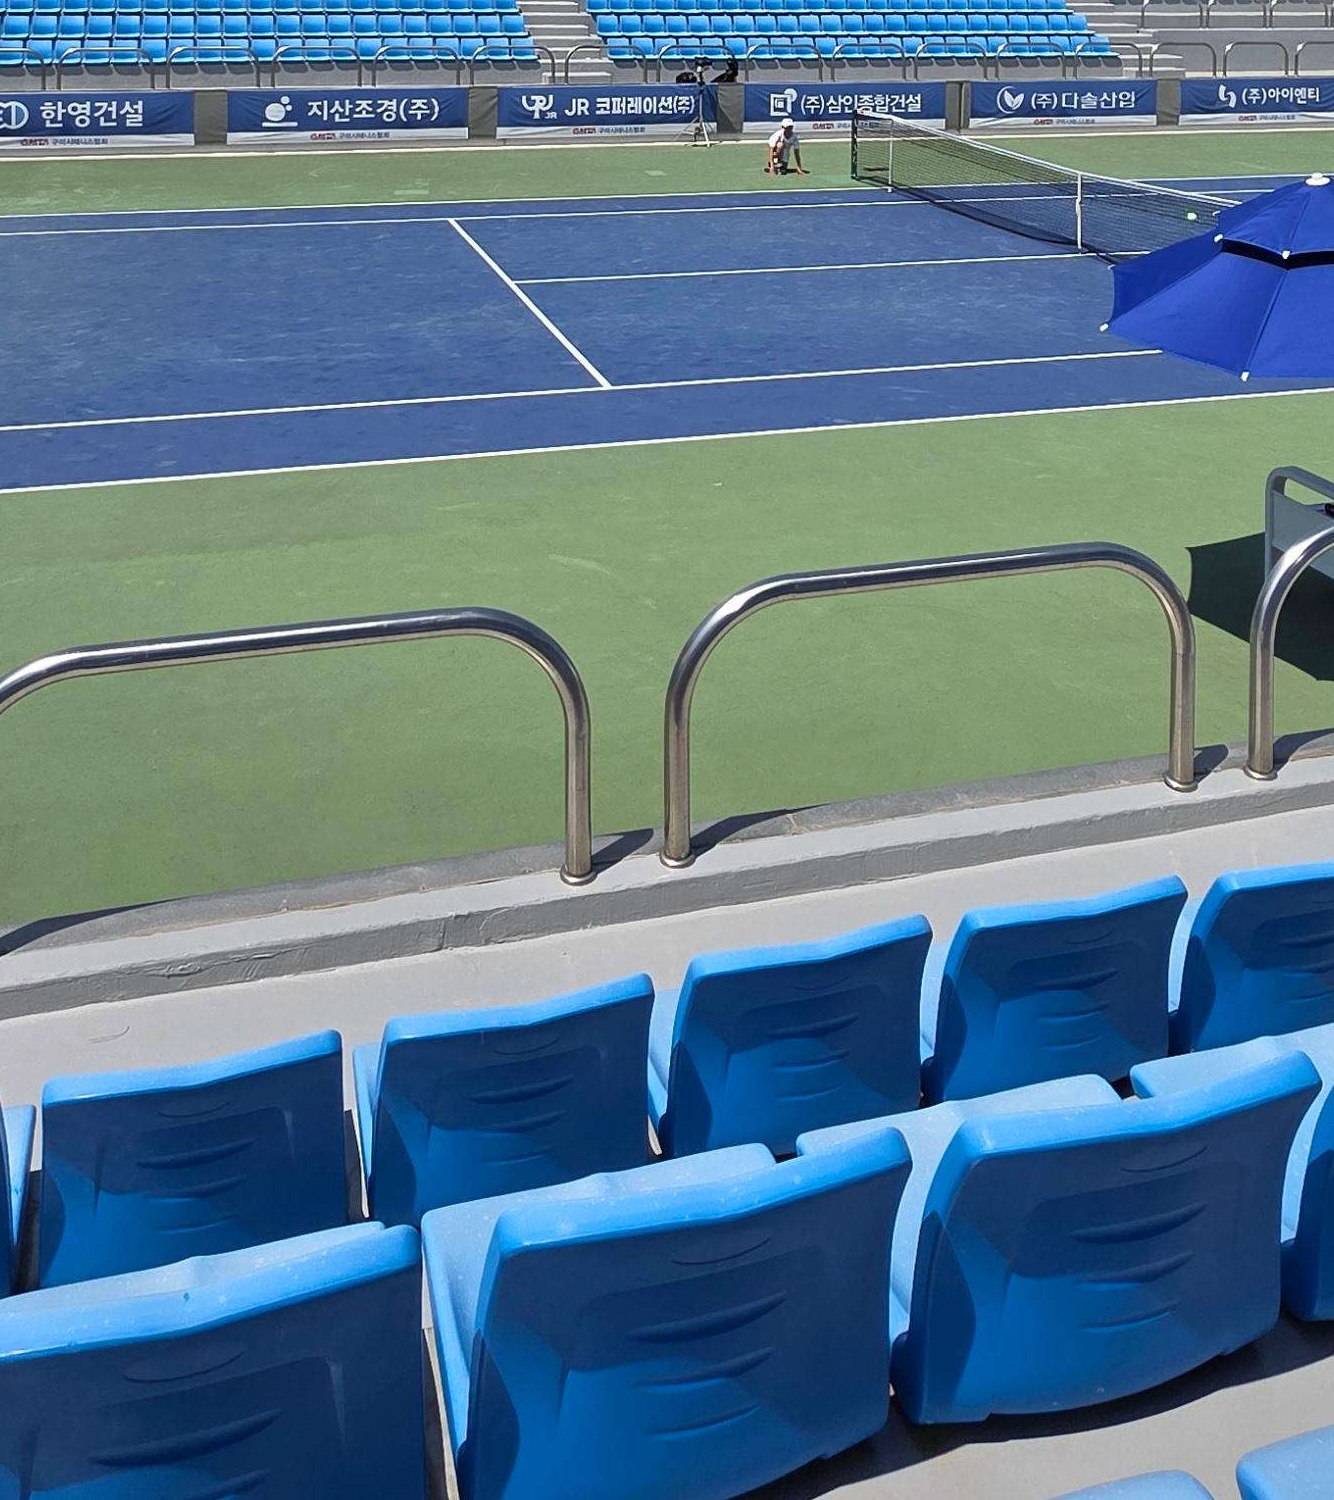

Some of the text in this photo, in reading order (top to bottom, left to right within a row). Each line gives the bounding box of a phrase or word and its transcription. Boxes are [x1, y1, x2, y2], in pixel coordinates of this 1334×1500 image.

[564, 95, 695, 116] JR 코퍼레이션(주)
[1242, 87, 1320, 105] (주)아이엔티
[40, 100, 144, 128] 한영건설
[307, 98, 440, 122] 지산조경(주)
